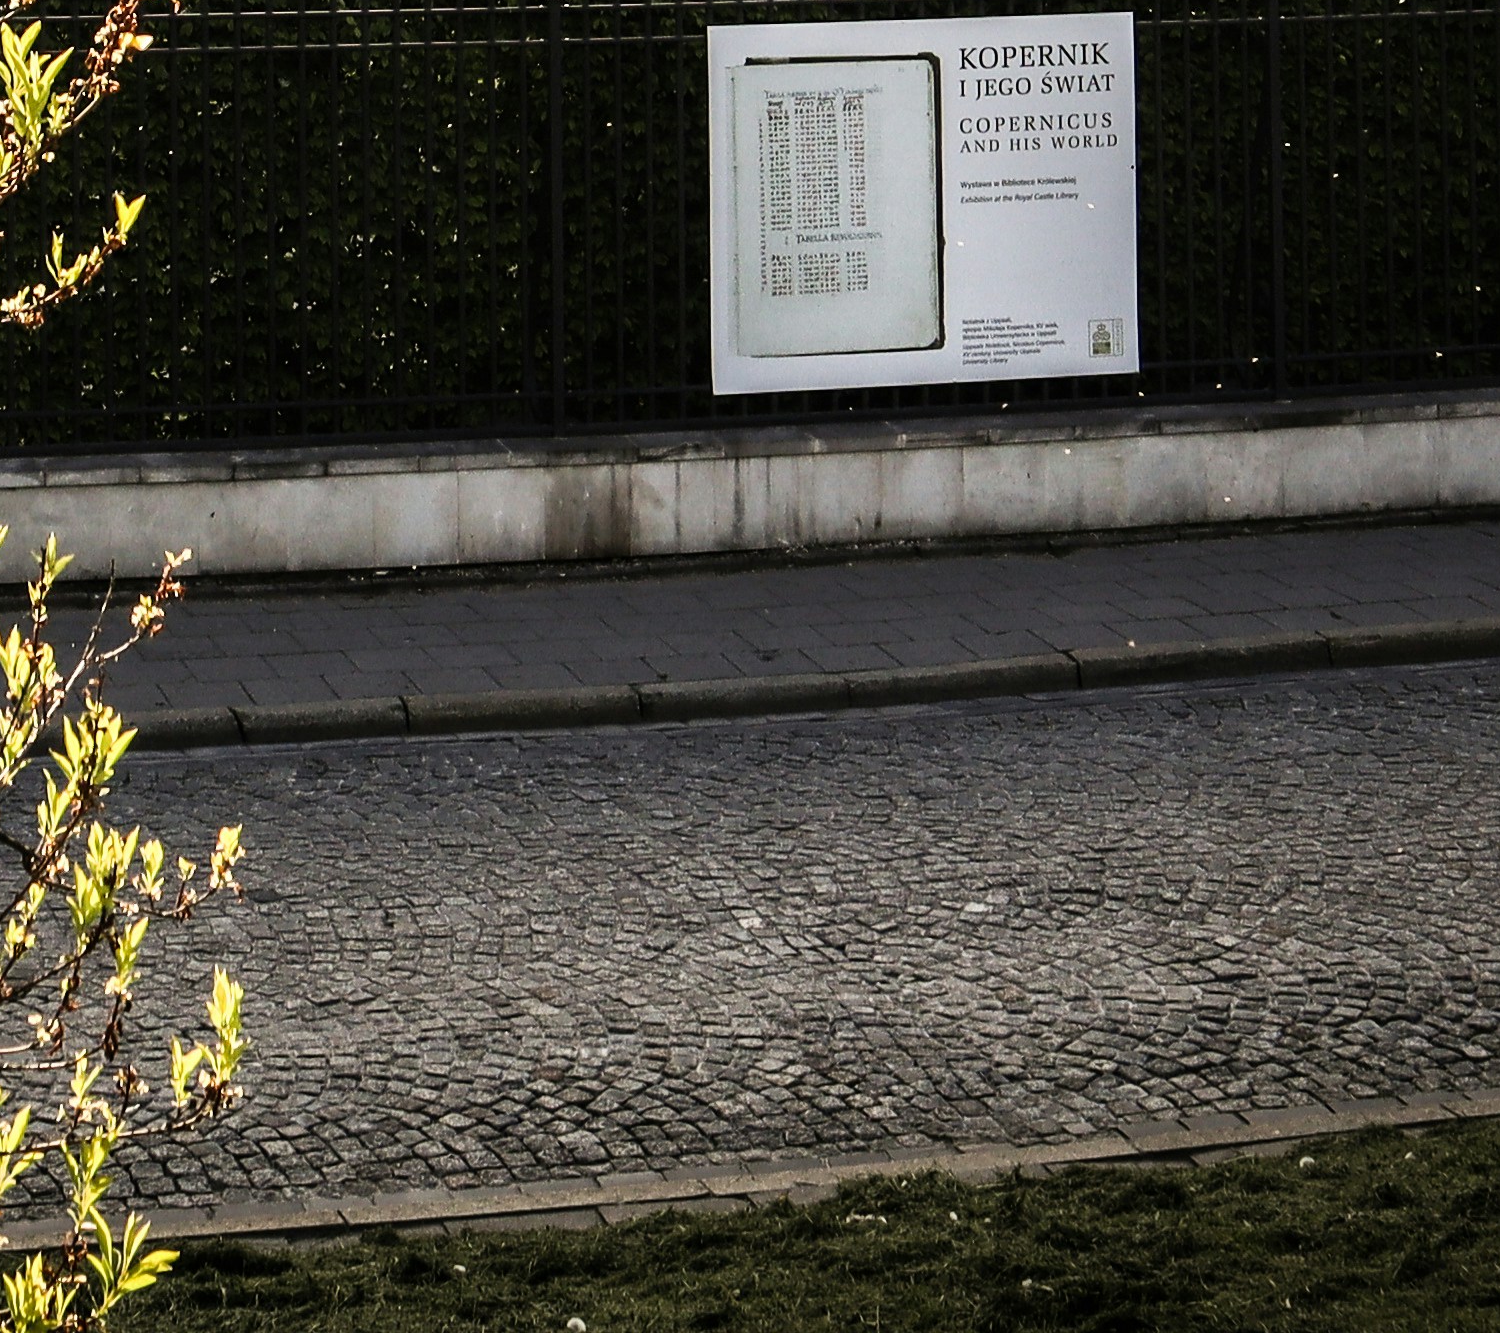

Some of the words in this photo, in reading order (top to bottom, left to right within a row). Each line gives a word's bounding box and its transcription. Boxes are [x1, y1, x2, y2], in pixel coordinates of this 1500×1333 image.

[958, 42, 1110, 70] KOPERNIK
[959, 79, 966, 97] I
[975, 77, 1032, 101] JEGO
[1040, 71, 1115, 95] ŚWIAT
[959, 112, 1112, 134] COPERNICUS
[960, 139, 1000, 153] AND
[1010, 137, 1041, 151] HIS
[1051, 133, 1118, 149] WORLD
